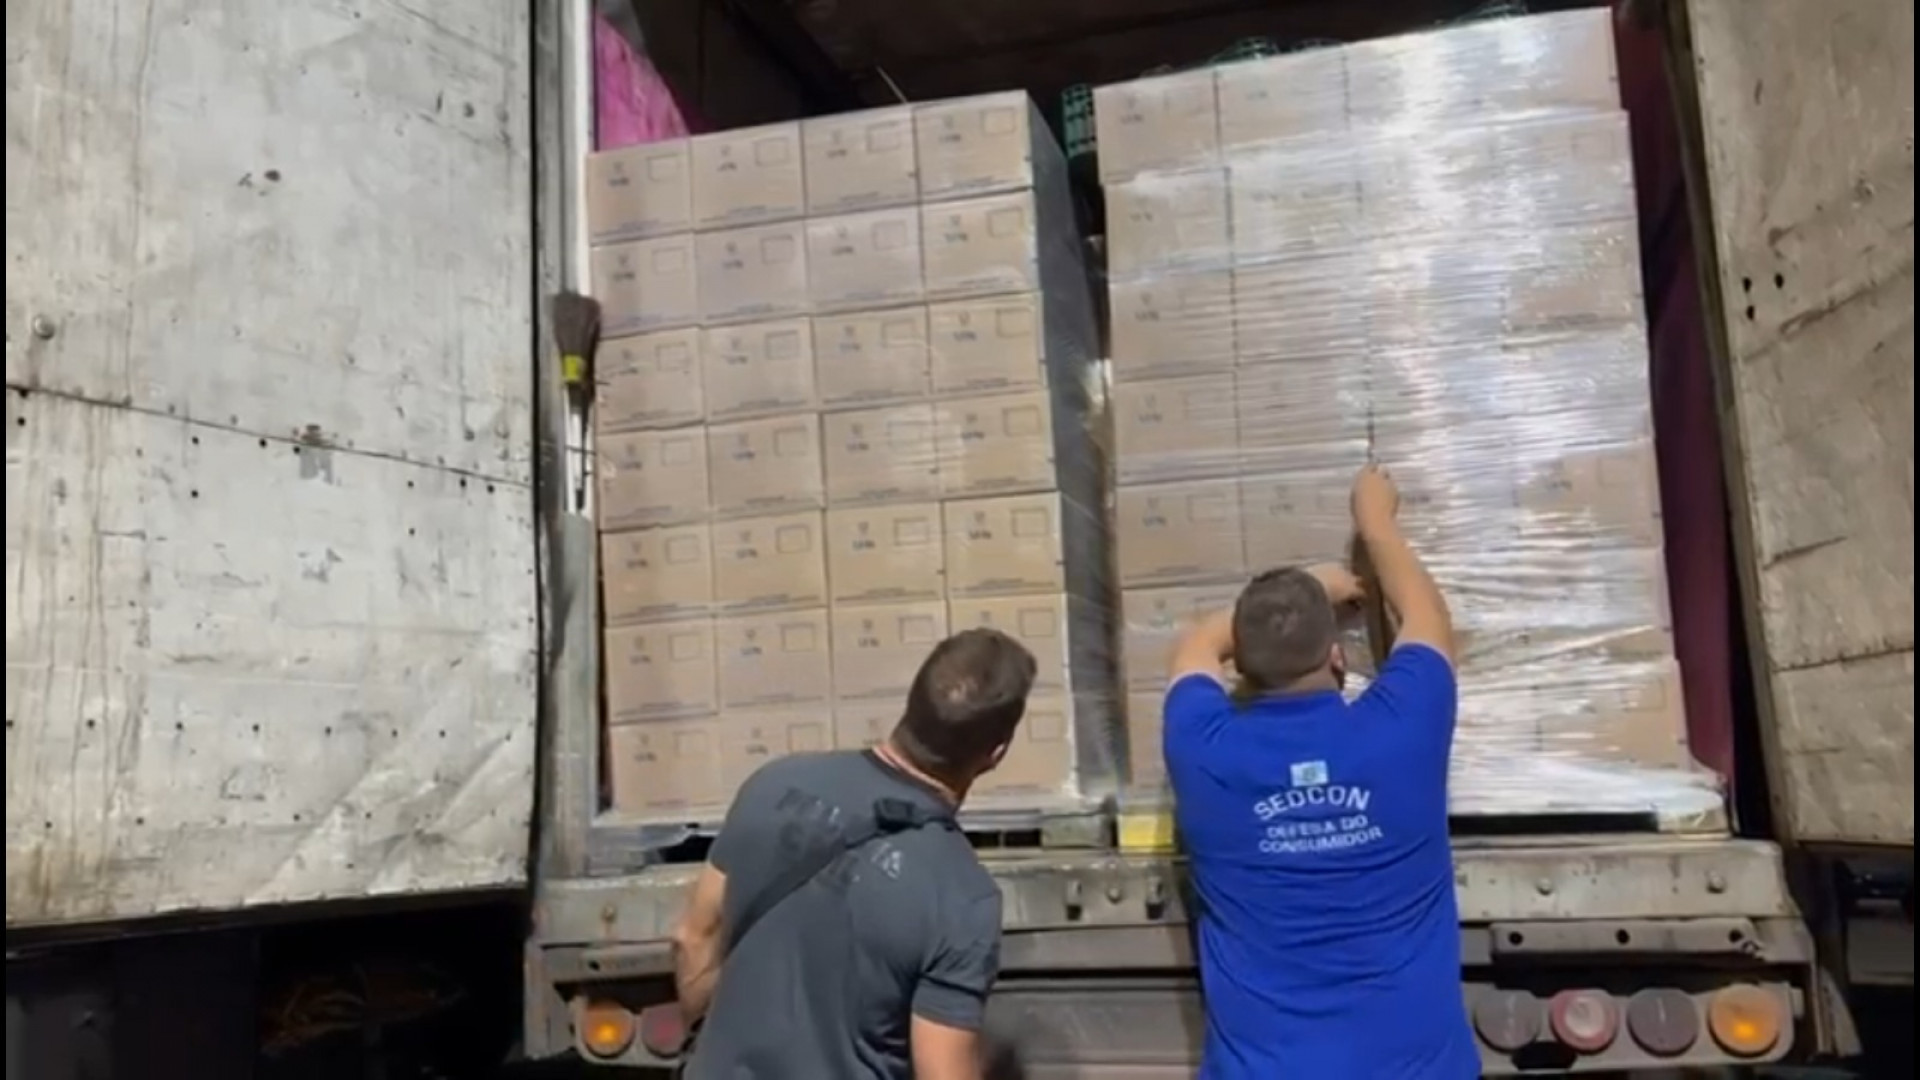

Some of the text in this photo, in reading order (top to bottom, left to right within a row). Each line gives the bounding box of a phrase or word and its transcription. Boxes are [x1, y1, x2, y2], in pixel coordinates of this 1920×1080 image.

[1253, 786, 1370, 821] SEDCON
[1259, 826, 1383, 853] CONSUMIDOR
[1267, 815, 1369, 839] DEFESA DO
